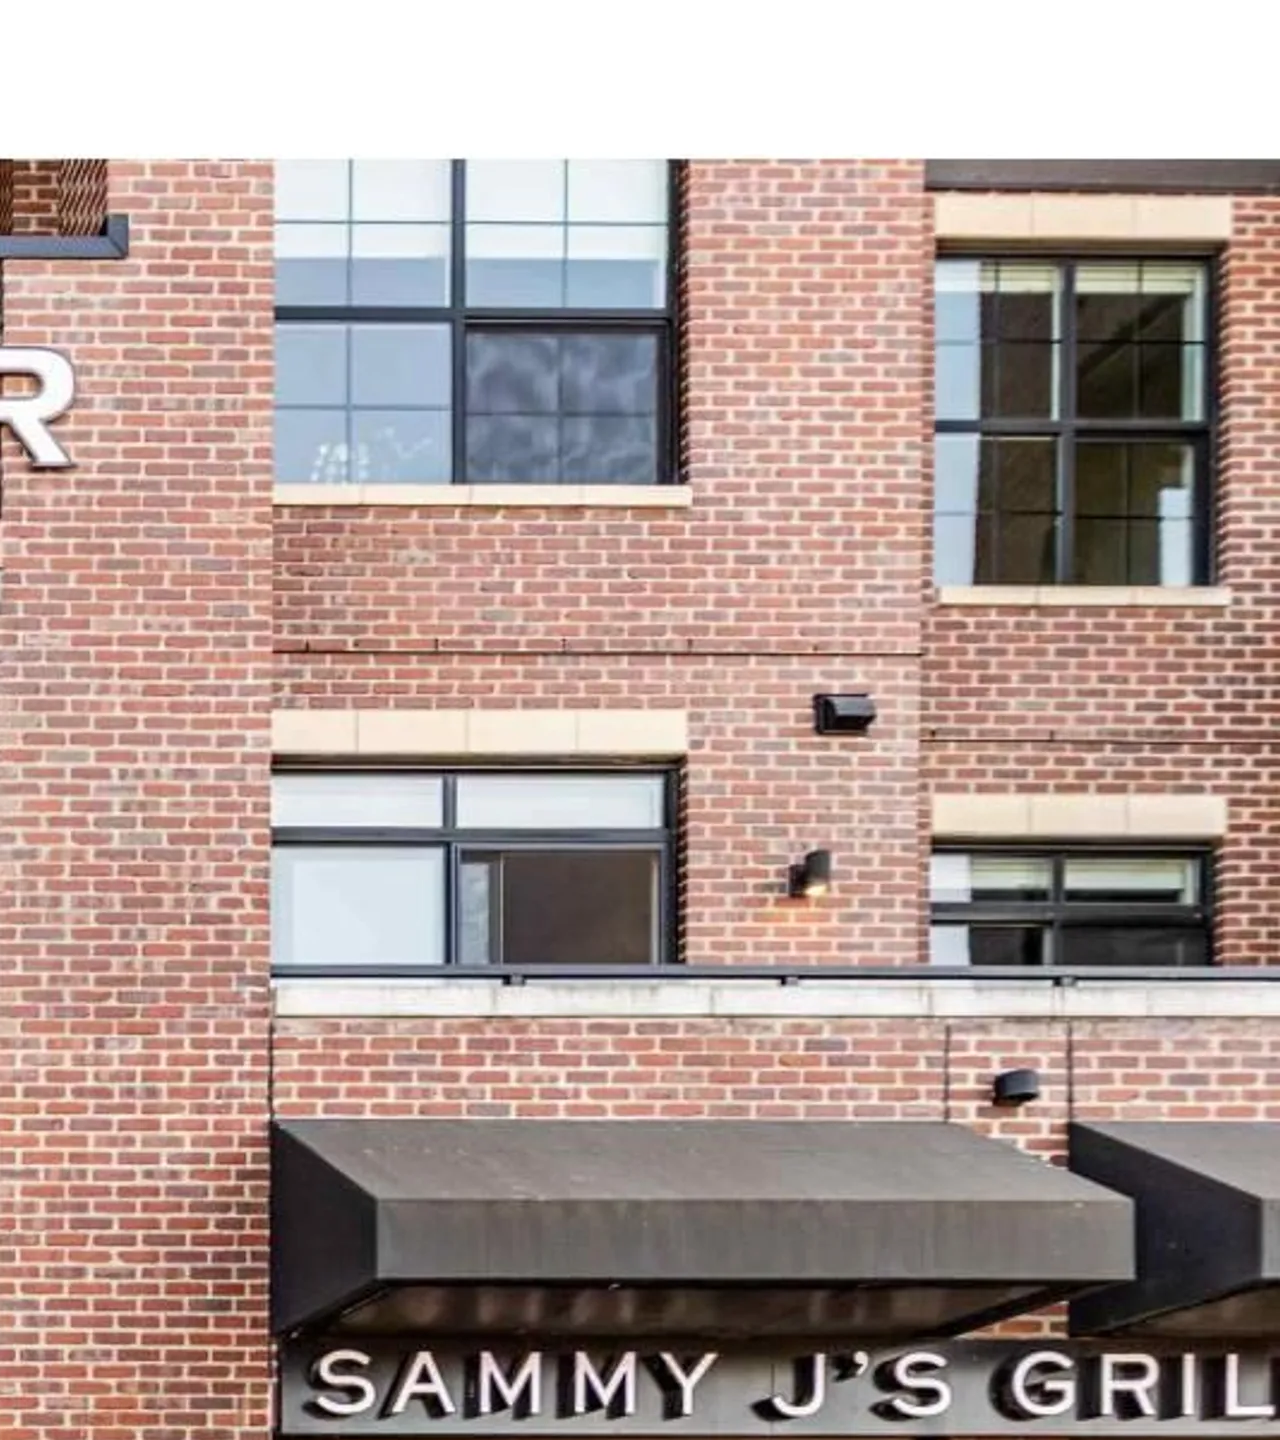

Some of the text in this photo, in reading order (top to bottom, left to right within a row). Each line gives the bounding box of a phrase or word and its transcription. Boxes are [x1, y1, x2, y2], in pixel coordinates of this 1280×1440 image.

[316, 1349, 1276, 1417] SAMMY J'S GRIL
